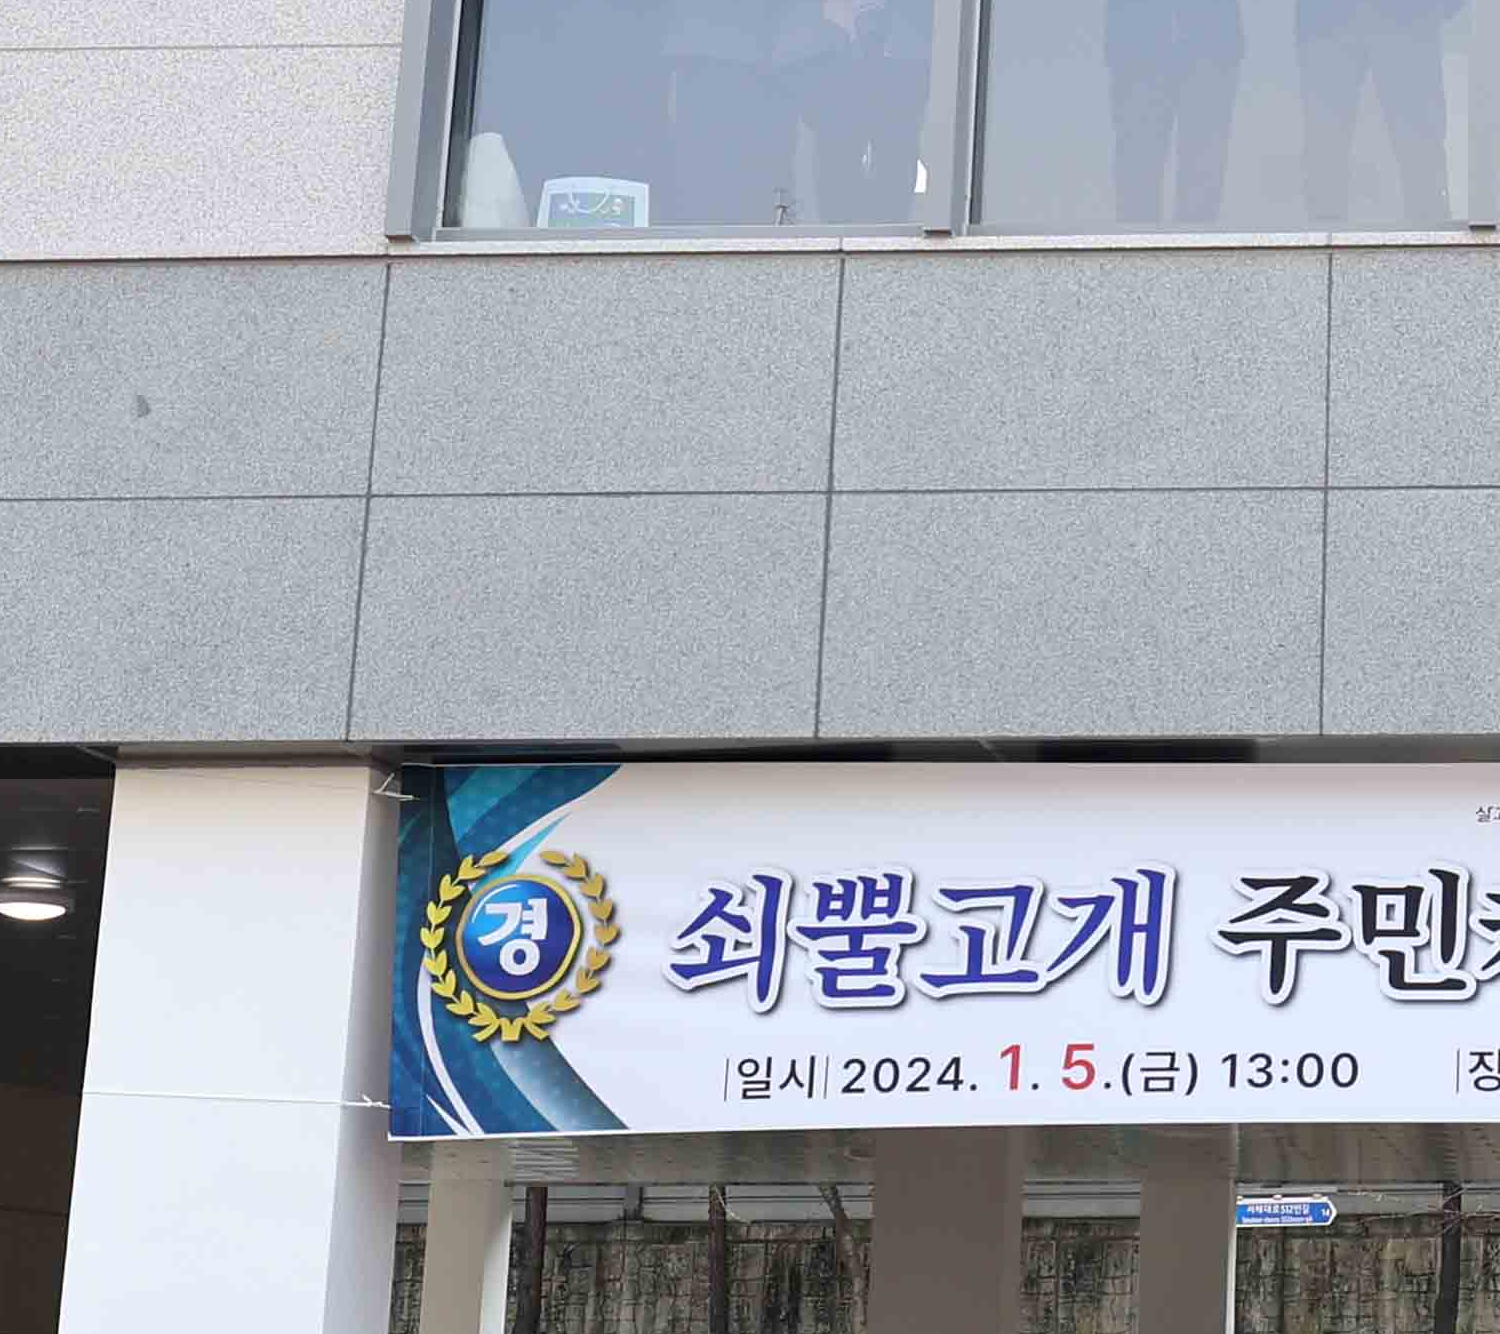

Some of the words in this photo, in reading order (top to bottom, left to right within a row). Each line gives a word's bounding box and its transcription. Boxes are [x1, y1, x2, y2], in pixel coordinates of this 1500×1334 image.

[476, 897, 550, 976] 경
[668, 867, 1172, 1000] 쇠뿔고개
[840, 1056, 978, 1094] 2024.
[999, 1043, 1040, 1092] 1.
[1220, 1051, 1360, 1090] 13:00
